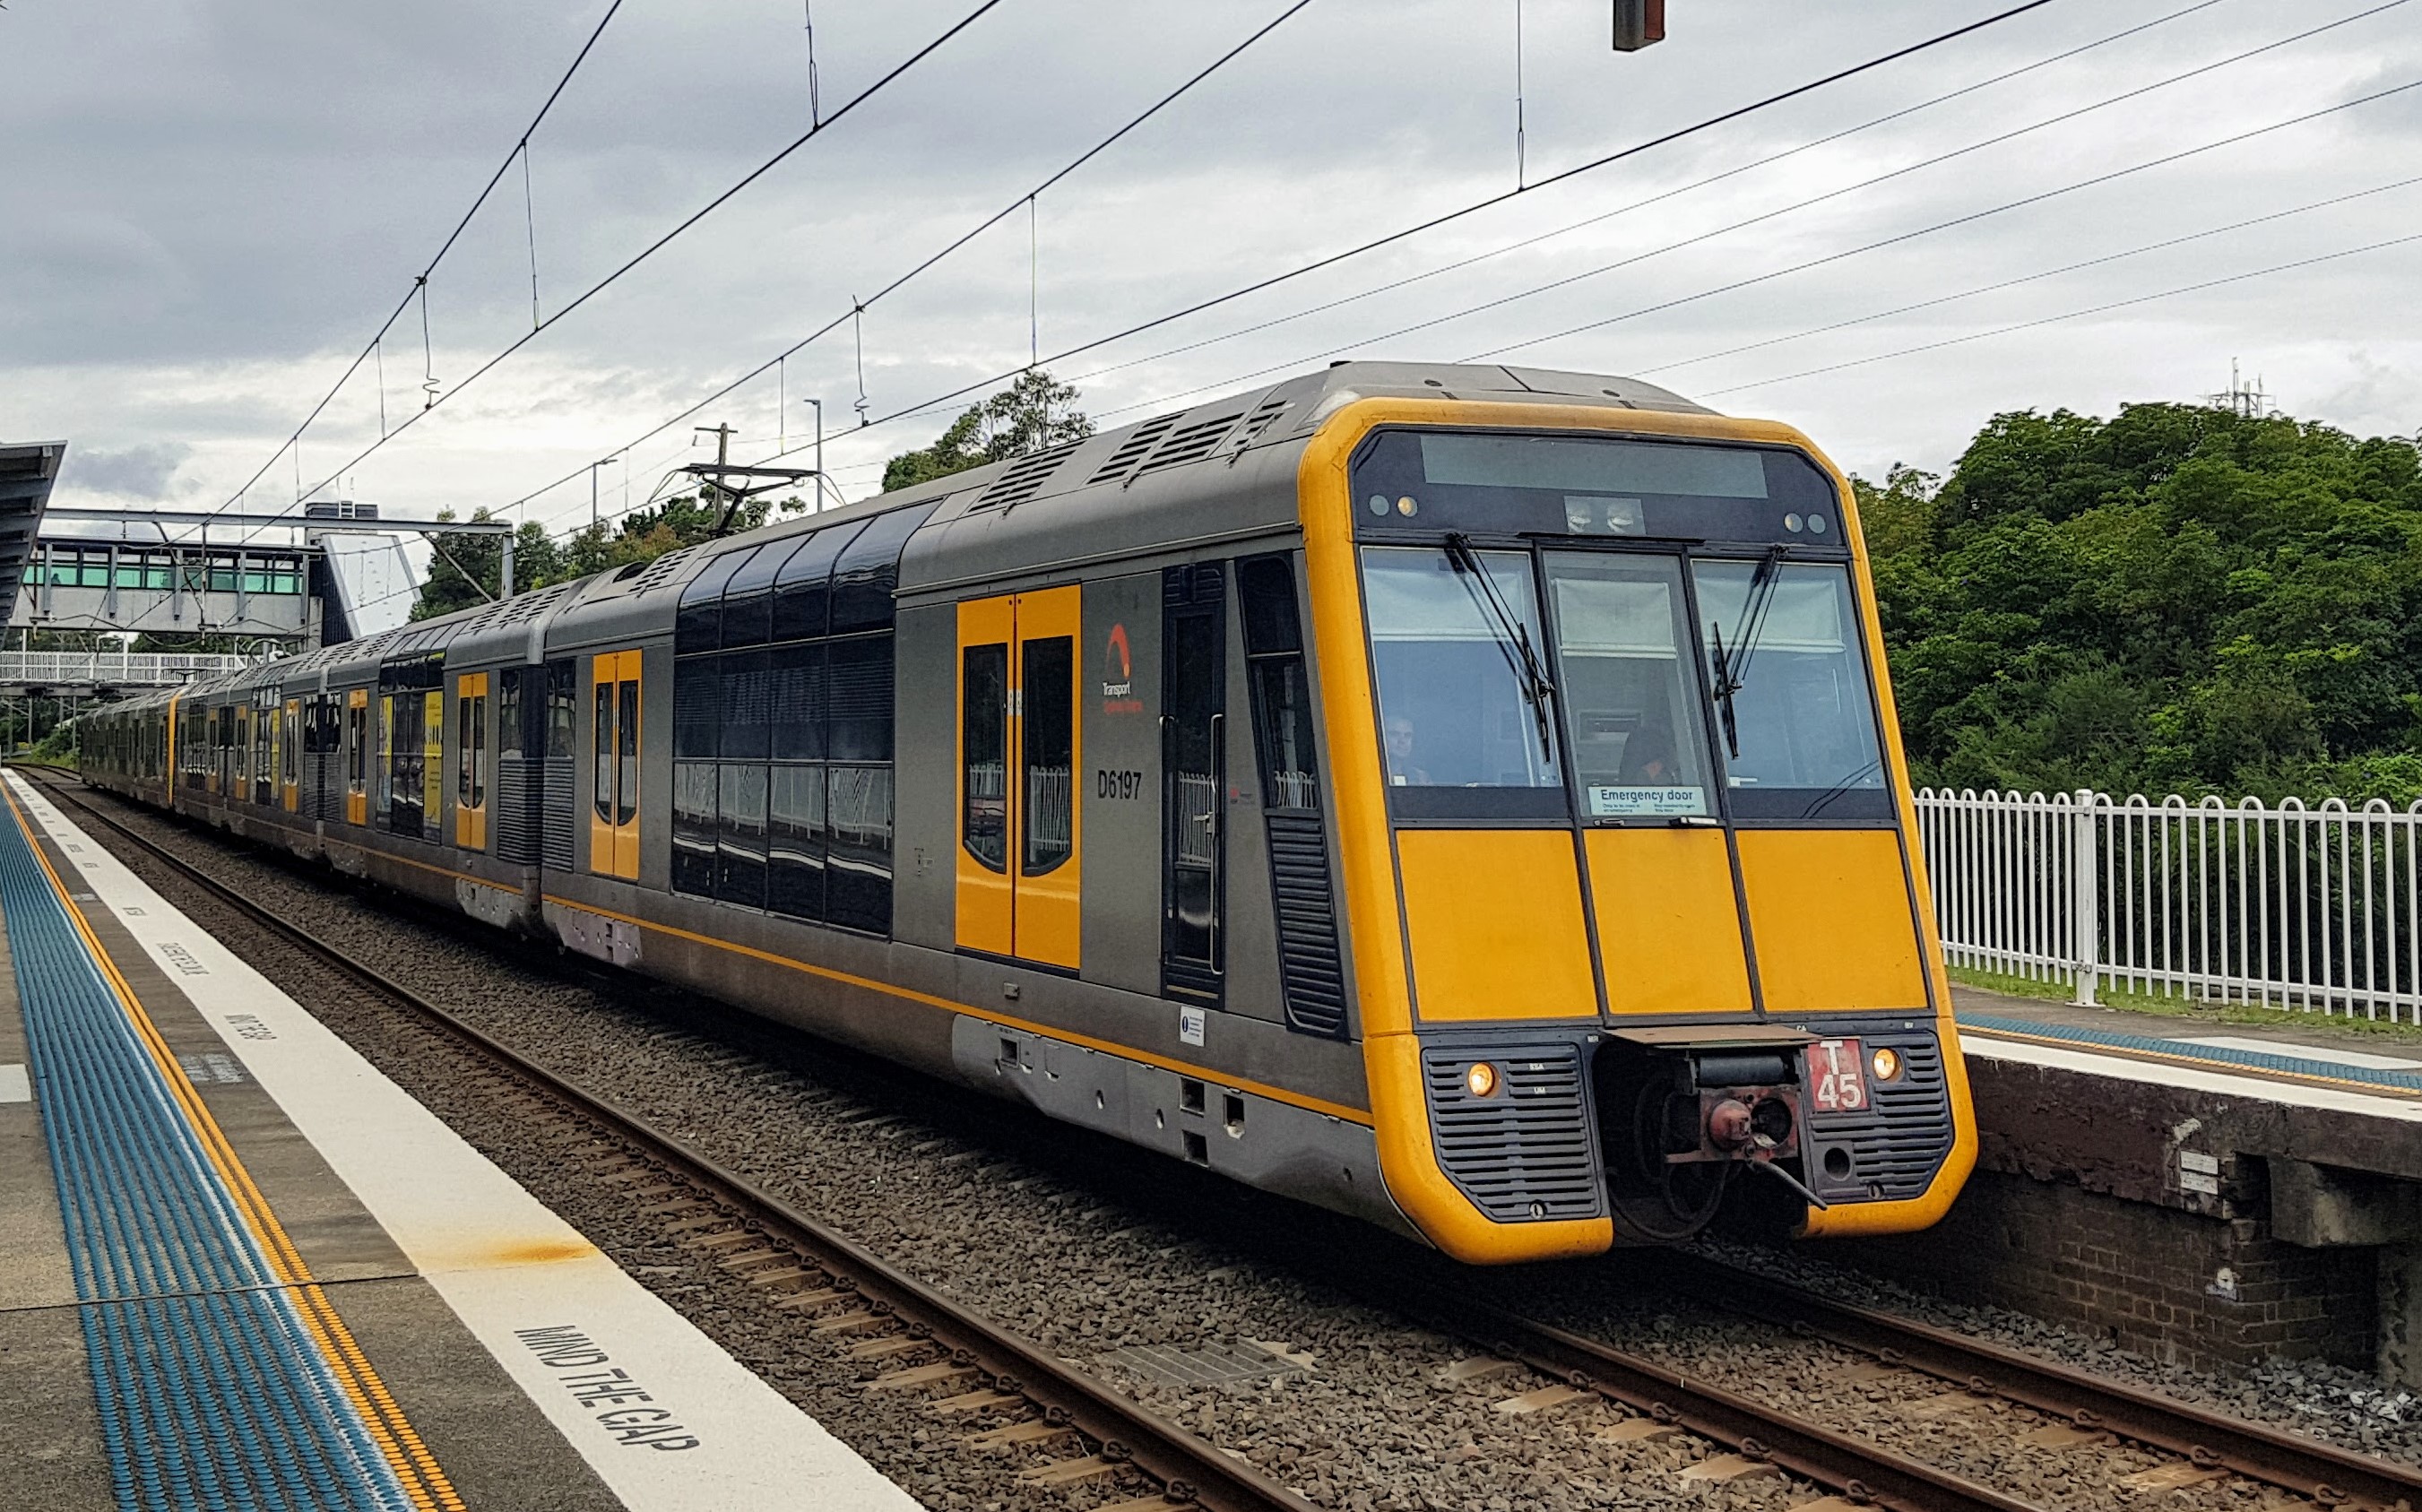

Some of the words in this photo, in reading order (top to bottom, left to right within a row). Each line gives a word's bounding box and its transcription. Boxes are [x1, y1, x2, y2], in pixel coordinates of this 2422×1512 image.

[1103, 681, 1131, 697] Transport
[1098, 770, 1142, 800] D6197
[1601, 790, 1664, 803] Emergency
[1667, 790, 1693, 800] door
[1820, 1040, 1844, 1076] T
[1817, 1073, 1862, 1109] 45
[514, 1325, 610, 1368] MIND
[558, 1368, 654, 1408] THE
[595, 1408, 701, 1451] GAP
